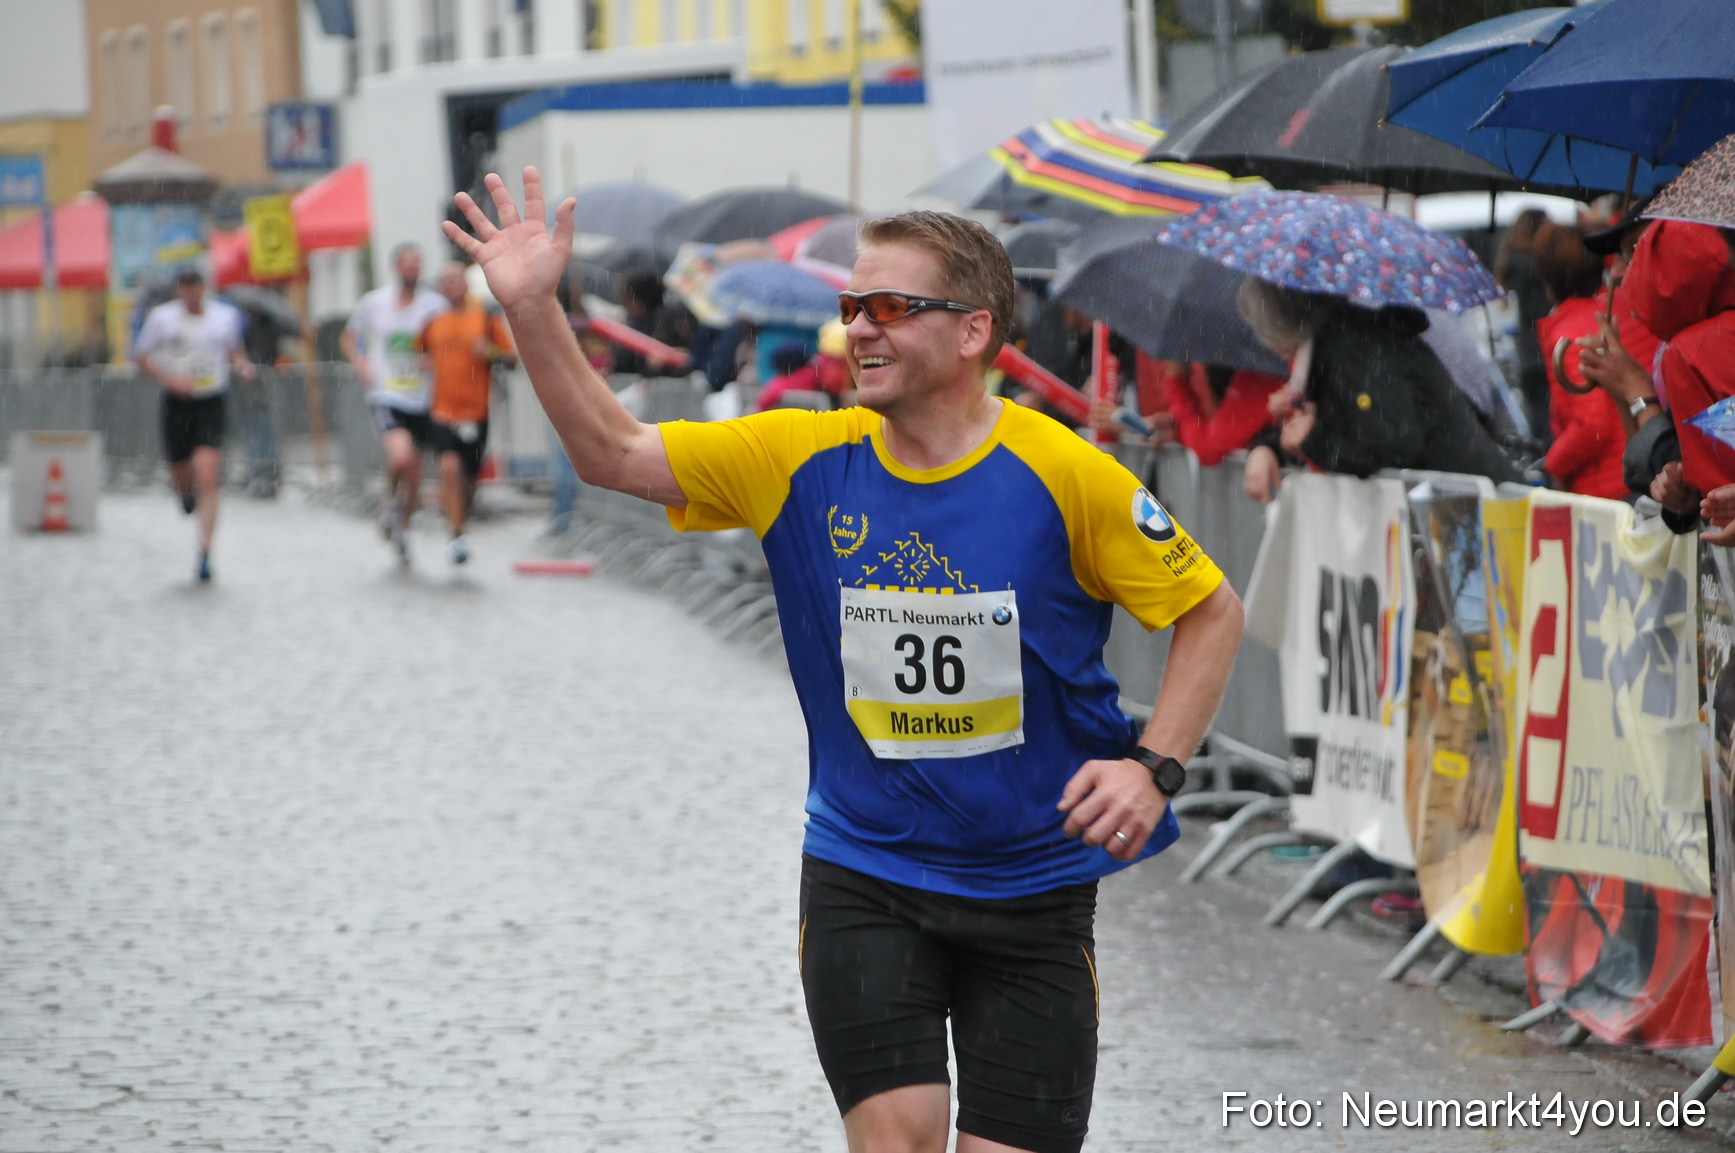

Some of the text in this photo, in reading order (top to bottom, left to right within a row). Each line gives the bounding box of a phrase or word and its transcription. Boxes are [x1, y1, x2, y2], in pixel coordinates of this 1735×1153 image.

[842, 515, 853, 525] 15
[833, 526, 857, 539] Jahre
[844, 605, 985, 626] PARTL Neumarkt
[894, 633, 966, 695] 36
[890, 711, 974, 735] Markus
